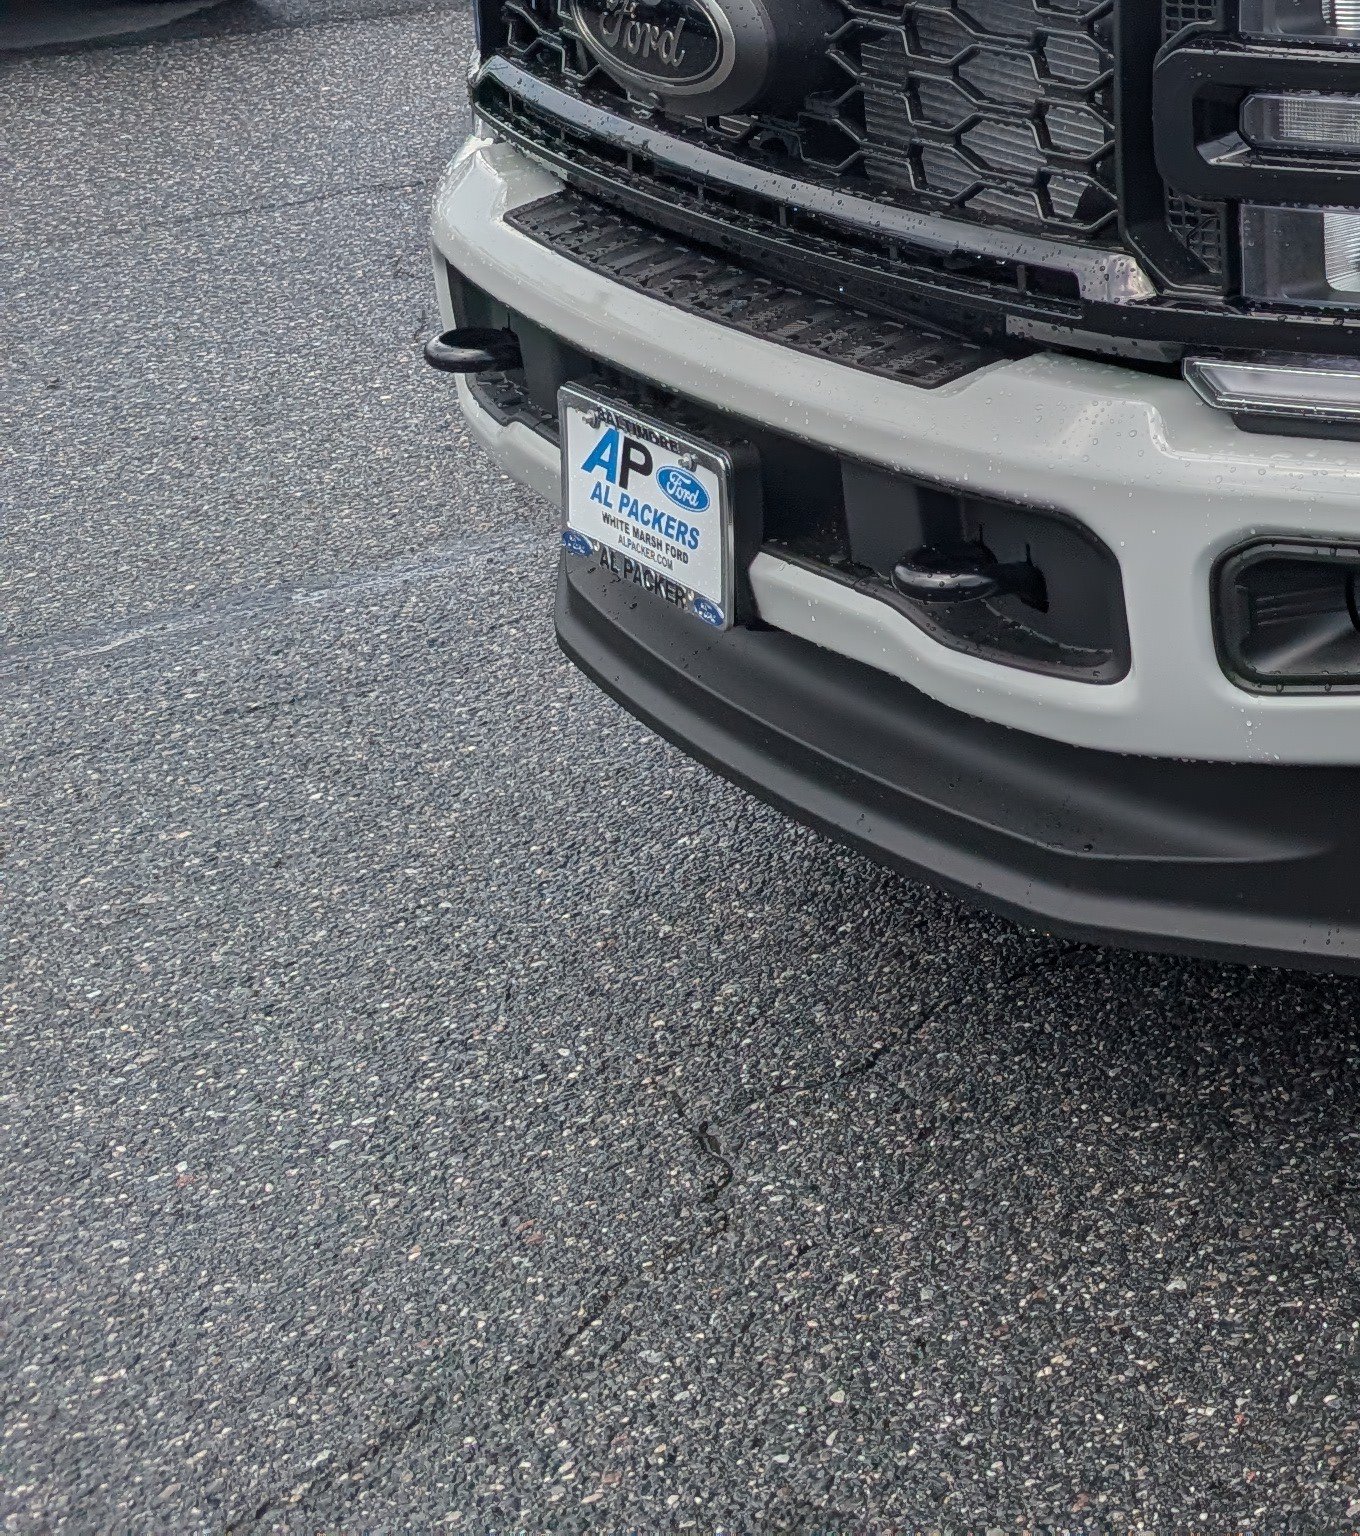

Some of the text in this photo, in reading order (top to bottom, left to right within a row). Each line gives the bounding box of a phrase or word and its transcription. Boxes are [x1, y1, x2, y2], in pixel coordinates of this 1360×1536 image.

[581, 427, 700, 507] AP Ford
[589, 481, 701, 550] AL PACKERS
[602, 511, 689, 564] WHITE MARSH FORD
[600, 546, 689, 611] AL PACKER
[618, 534, 674, 570] ALPACKER.COM
